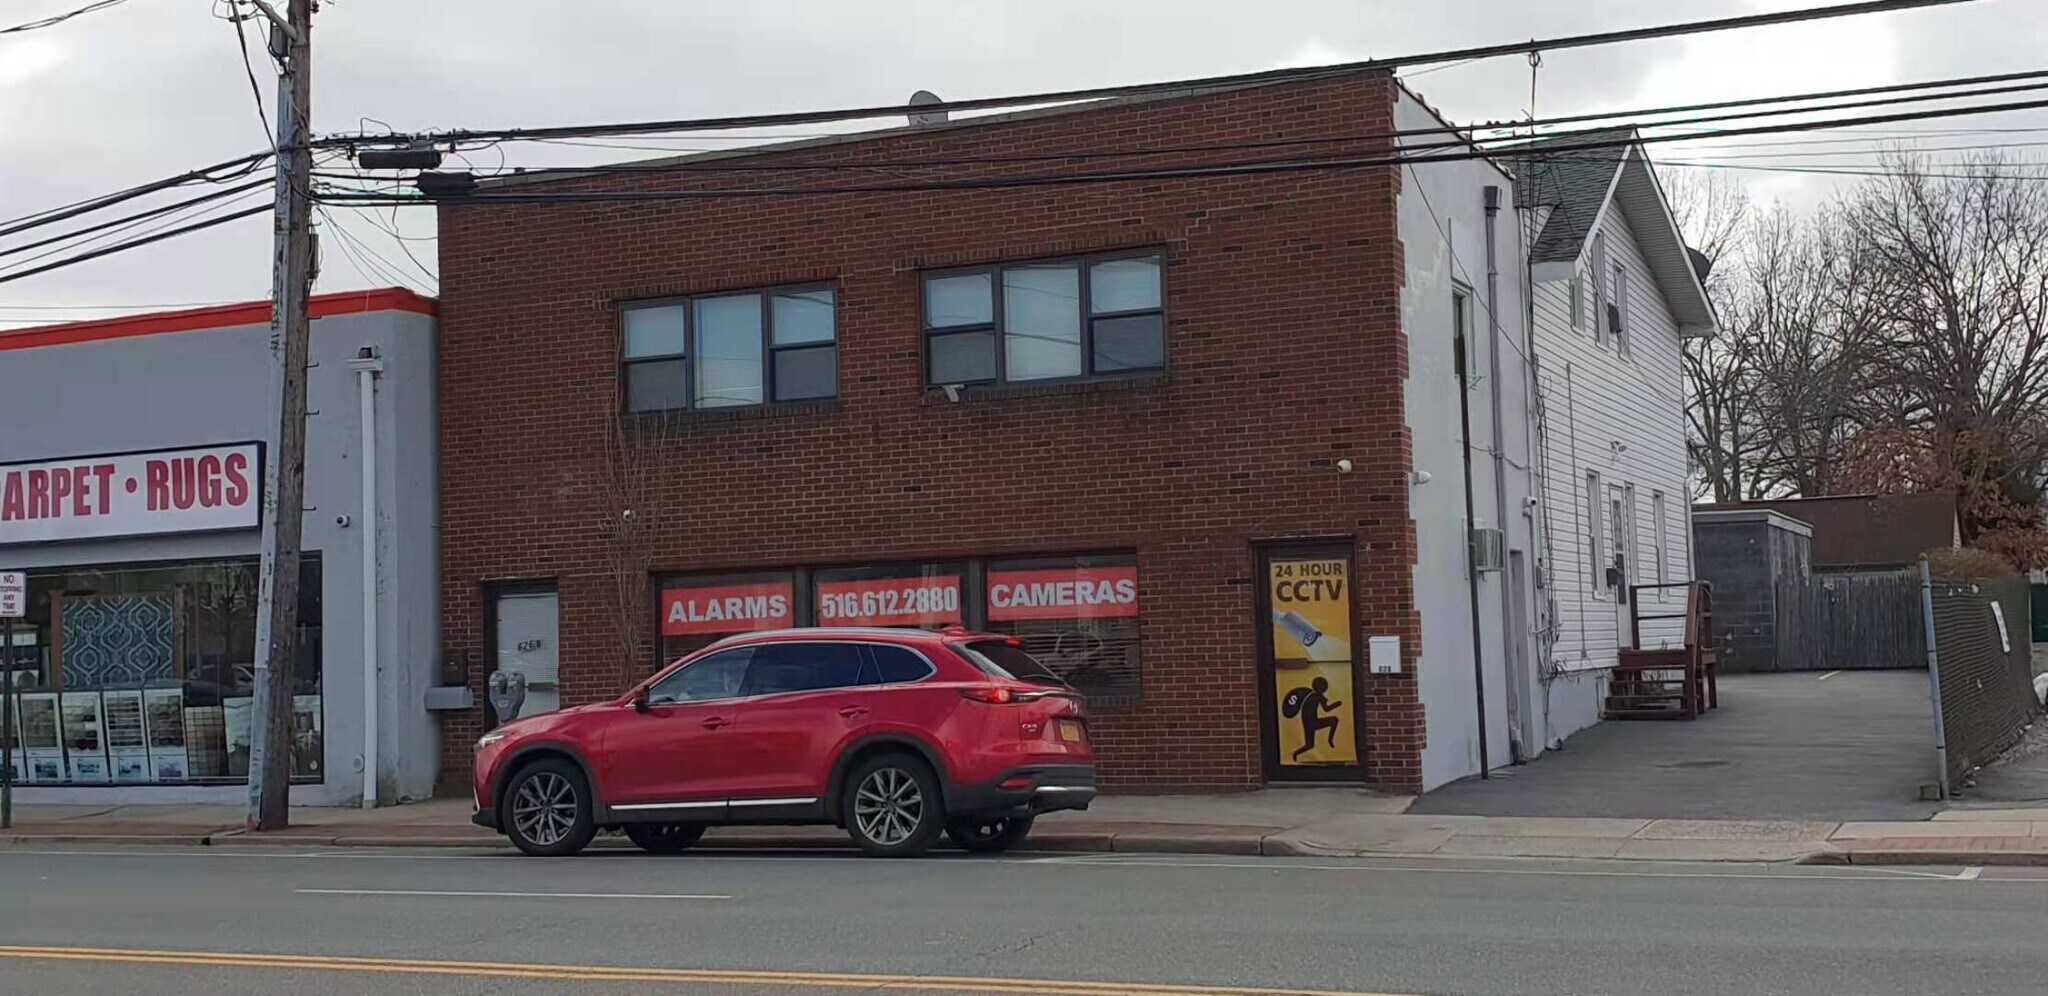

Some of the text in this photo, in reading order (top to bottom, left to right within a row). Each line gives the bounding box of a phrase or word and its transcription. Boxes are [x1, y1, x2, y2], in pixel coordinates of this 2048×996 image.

[0, 453, 248, 521] ARPET RUGS
[3, 574, 15, 584] NO
[1276, 563, 1342, 577] 24 HOUR
[822, 586, 958, 618] 516.612.2880
[991, 579, 1136, 608] CAMERAS
[1276, 580, 1342, 602] CCTV
[668, 594, 787, 623] ALARMS
